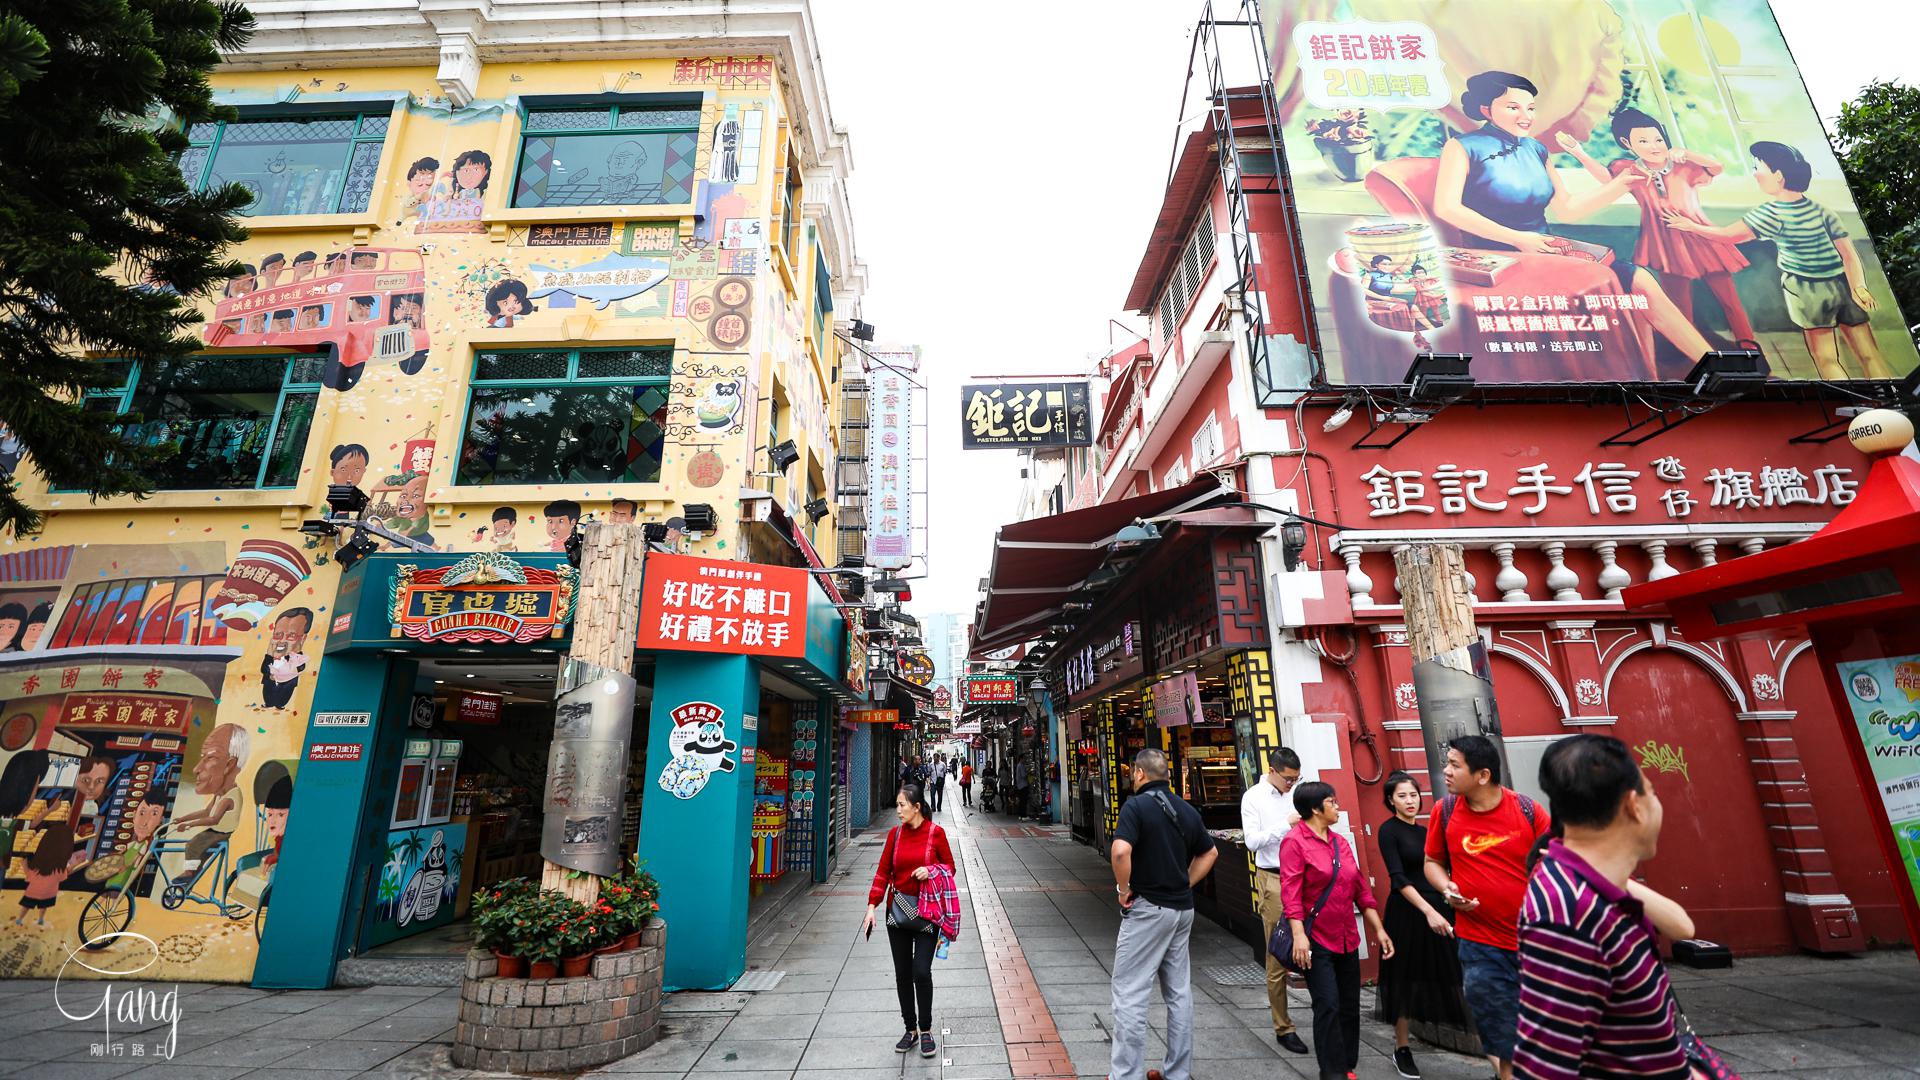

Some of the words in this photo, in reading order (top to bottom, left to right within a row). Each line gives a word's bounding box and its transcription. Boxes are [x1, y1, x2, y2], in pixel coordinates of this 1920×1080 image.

[1309, 34, 1426, 61] 鉅記餅家
[674, 54, 773, 85] 新中央
[1324, 68, 1431, 97] 20週年慶
[535, 226, 609, 239] 澳門佳作
[566, 238, 611, 246] creations
[966, 389, 1051, 437] 鉅記
[1053, 410, 1065, 433] 手信
[1359, 461, 1641, 519] 鉅記手信
[1703, 464, 1859, 510] 旗艦店
[421, 591, 540, 615] 官也墟
[661, 579, 791, 617] 好吃不離口
[434, 613, 469, 632] CUNHA
[474, 613, 515, 633] BAZAAR
[658, 612, 789, 648] 好禮不放手
[972, 683, 1012, 693] 澳門郵票
[70, 705, 179, 726] 咀香園餅家
